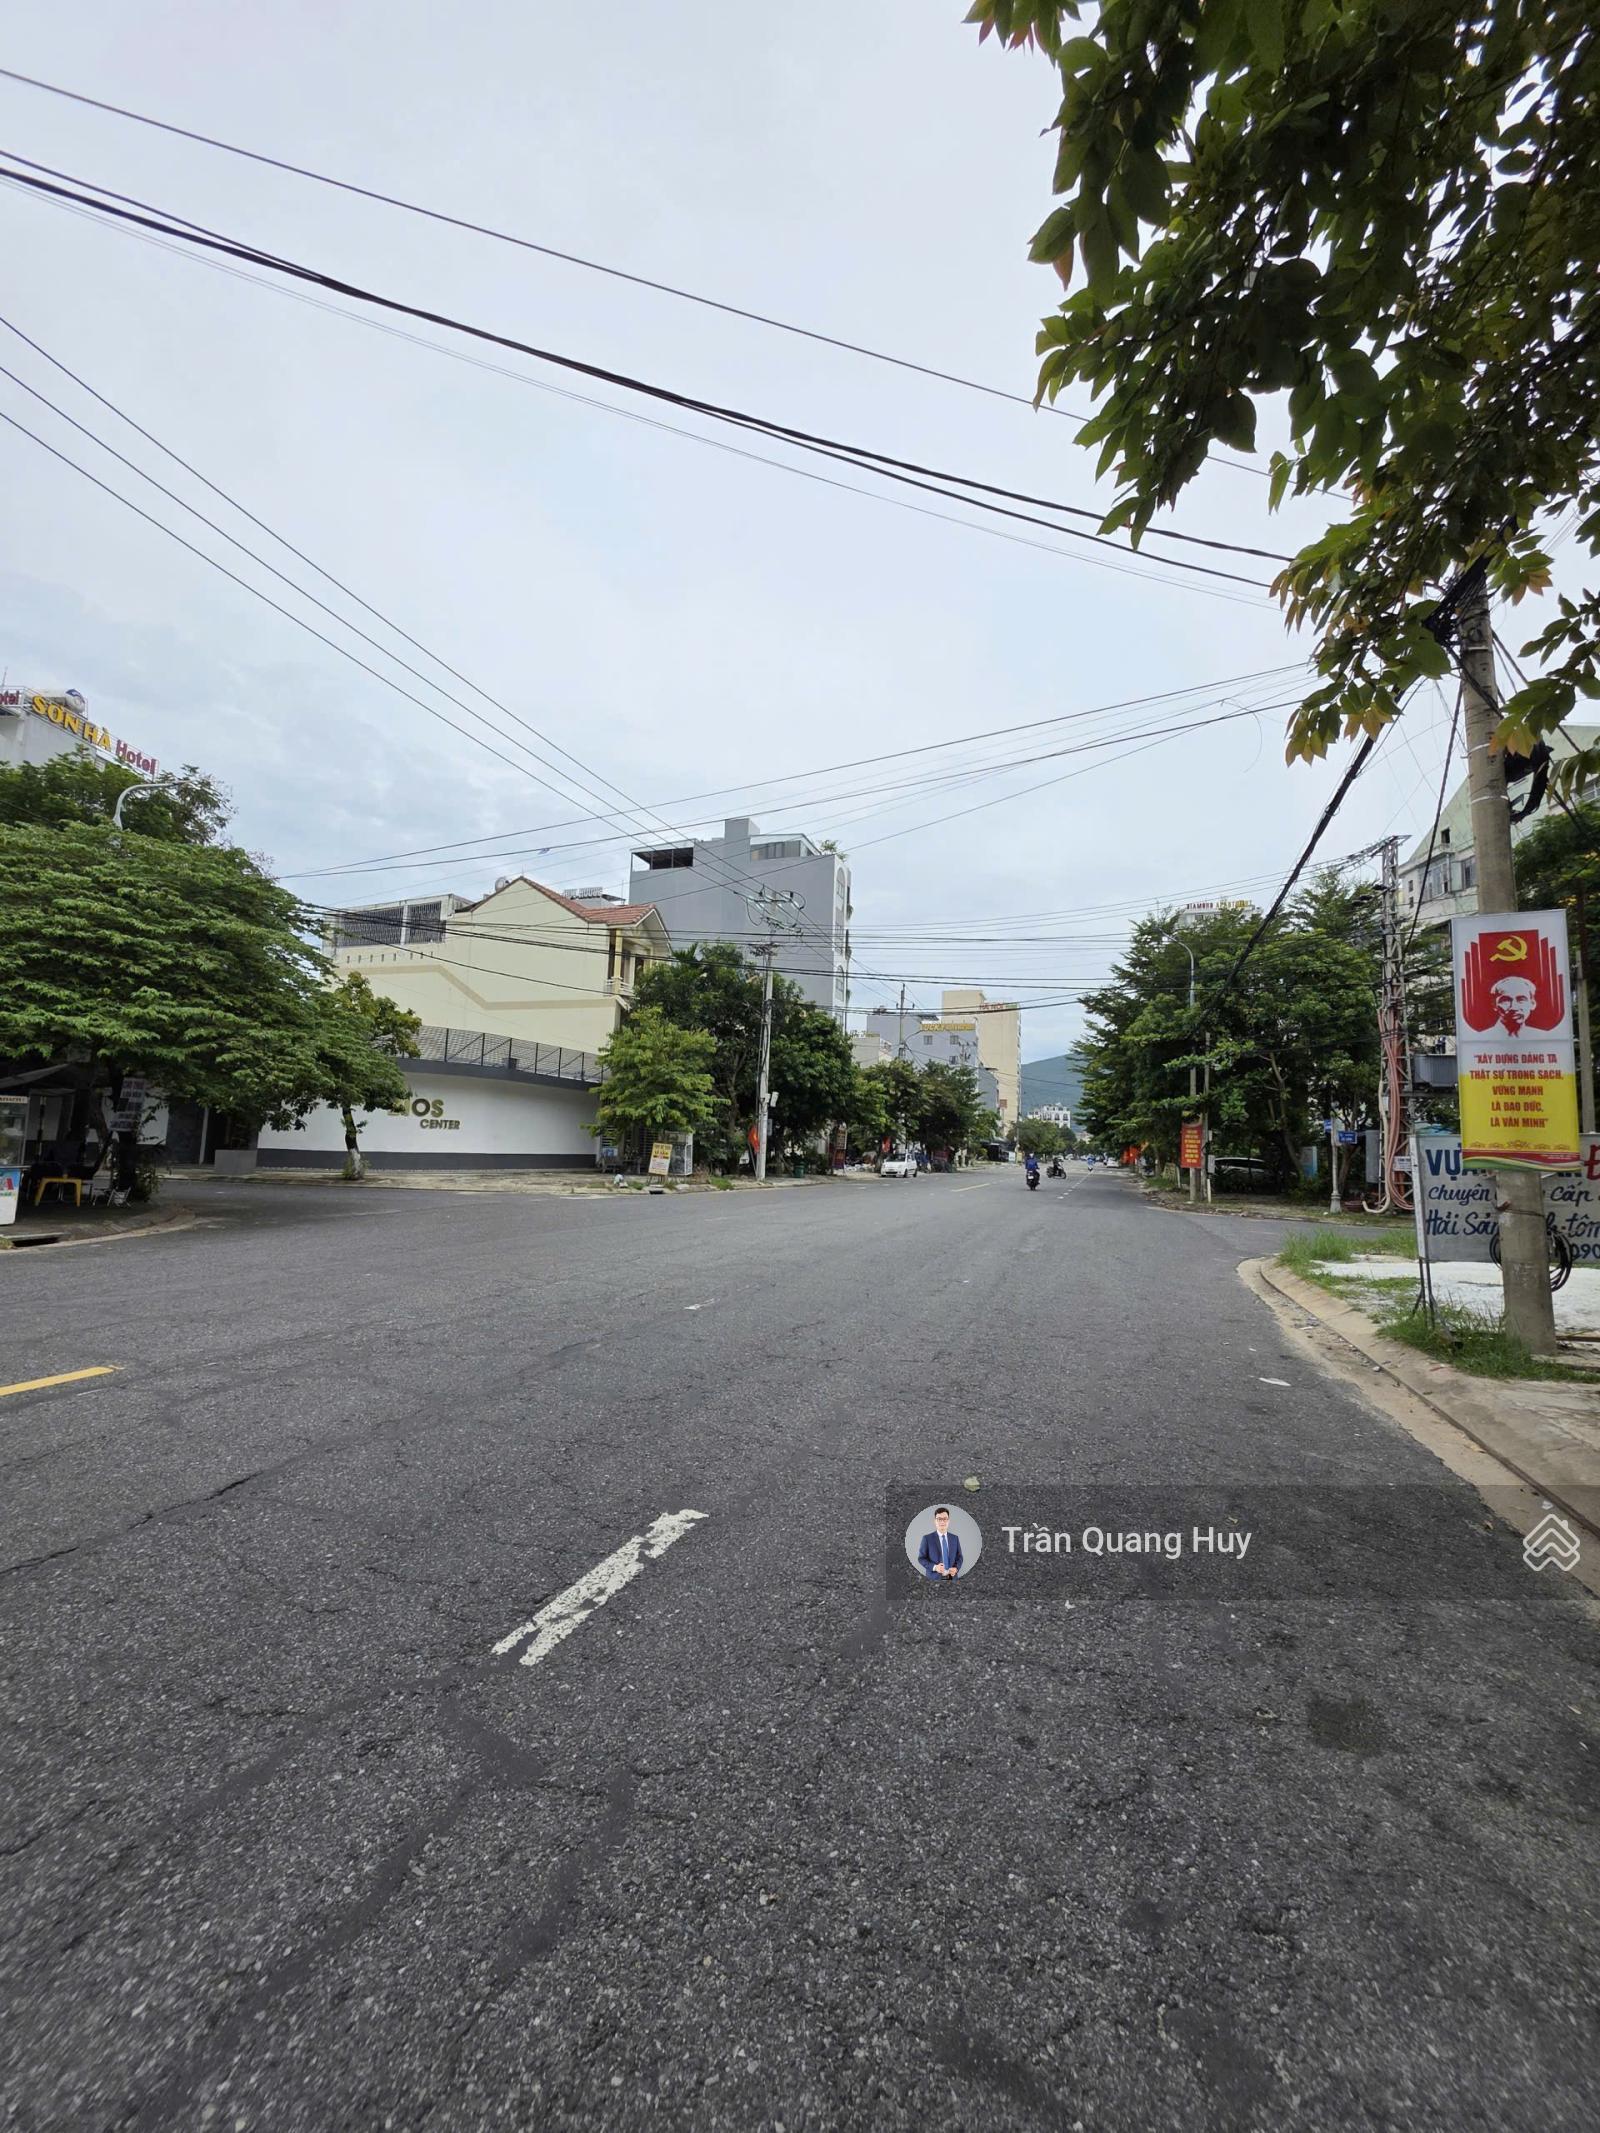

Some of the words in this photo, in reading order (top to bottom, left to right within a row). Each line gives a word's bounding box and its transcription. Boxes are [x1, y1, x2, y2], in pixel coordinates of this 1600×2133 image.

[32, 695, 80, 734] SƠN
[82, 722, 112, 751] HÀ
[115, 739, 157, 775] Hotel
[1547, 1053, 1557, 1063] TA
[1507, 1070, 1537, 1080] TRONG
[420, 1119, 460, 1129] CENTER
[1428, 1184, 1494, 1206] chuyên
[1425, 1210, 1459, 1236] Hải
